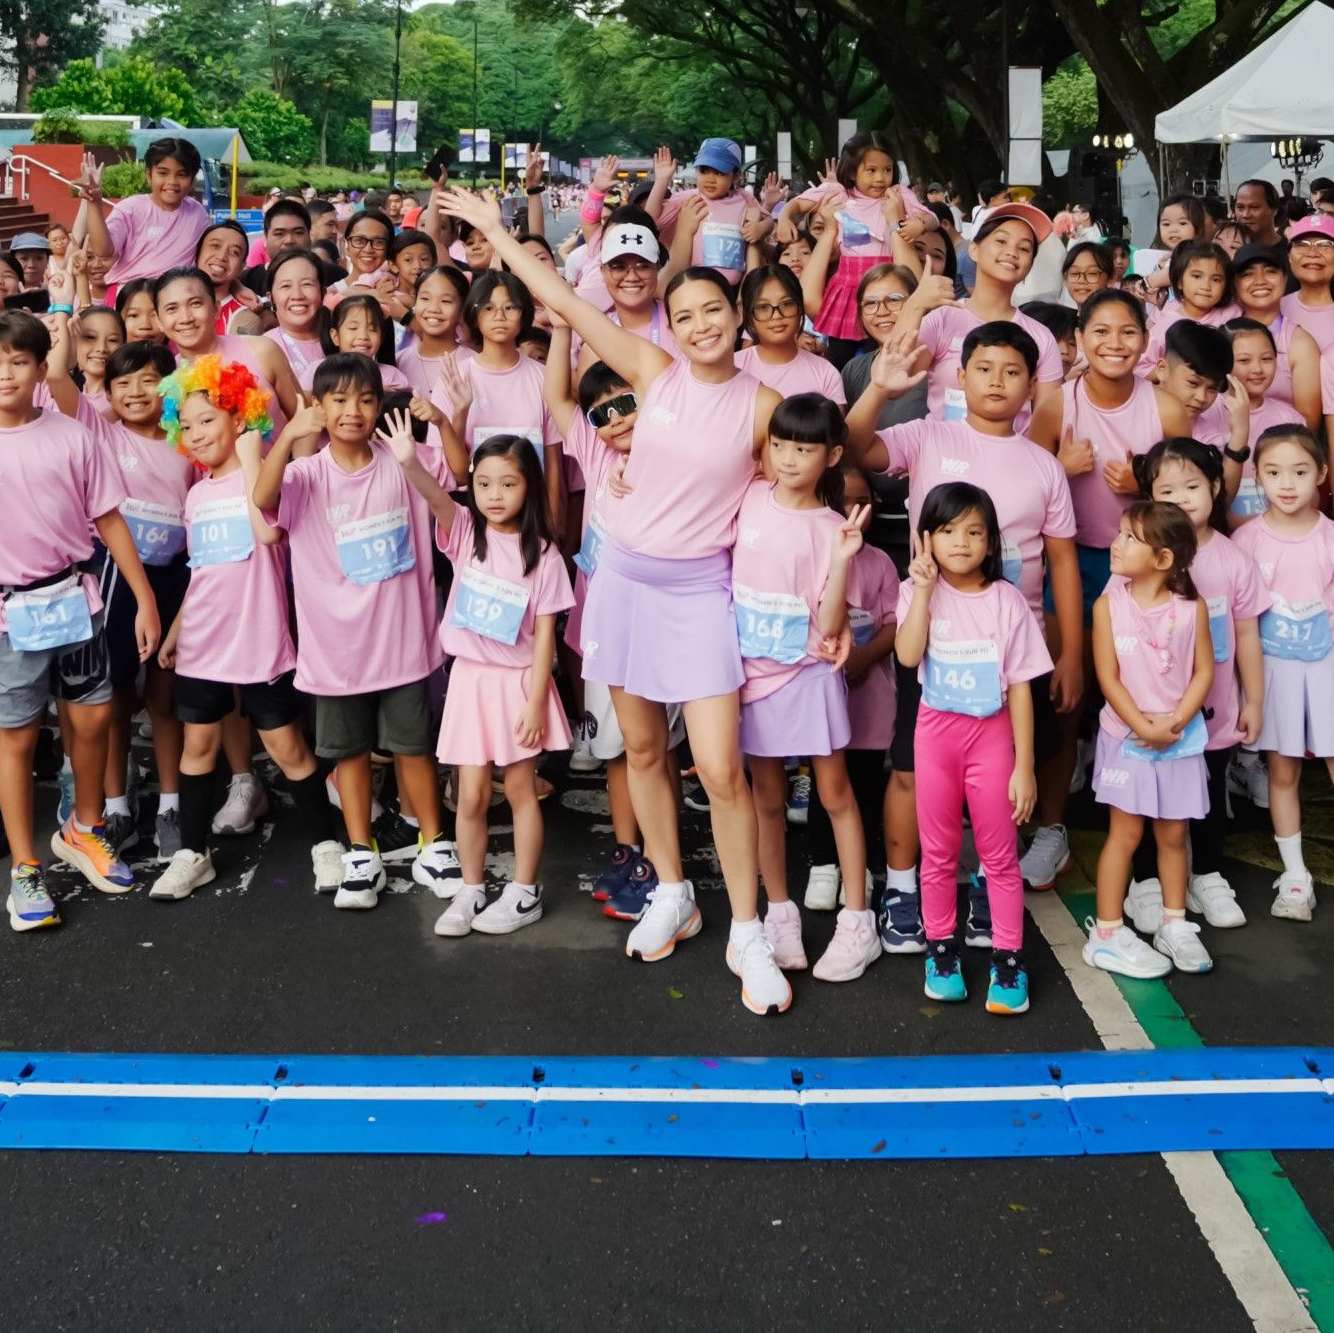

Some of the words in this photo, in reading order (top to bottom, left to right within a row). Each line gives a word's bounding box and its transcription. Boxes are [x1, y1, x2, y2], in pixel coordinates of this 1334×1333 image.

[718, 238, 741, 254] 172
[136, 523, 170, 545] 164
[201, 522, 229, 543] 101
[361, 535, 397, 561] 191
[29, 604, 68, 627] 161
[468, 595, 503, 625] 129
[1275, 619, 1313, 643] 217
[933, 665, 977, 691] 146
